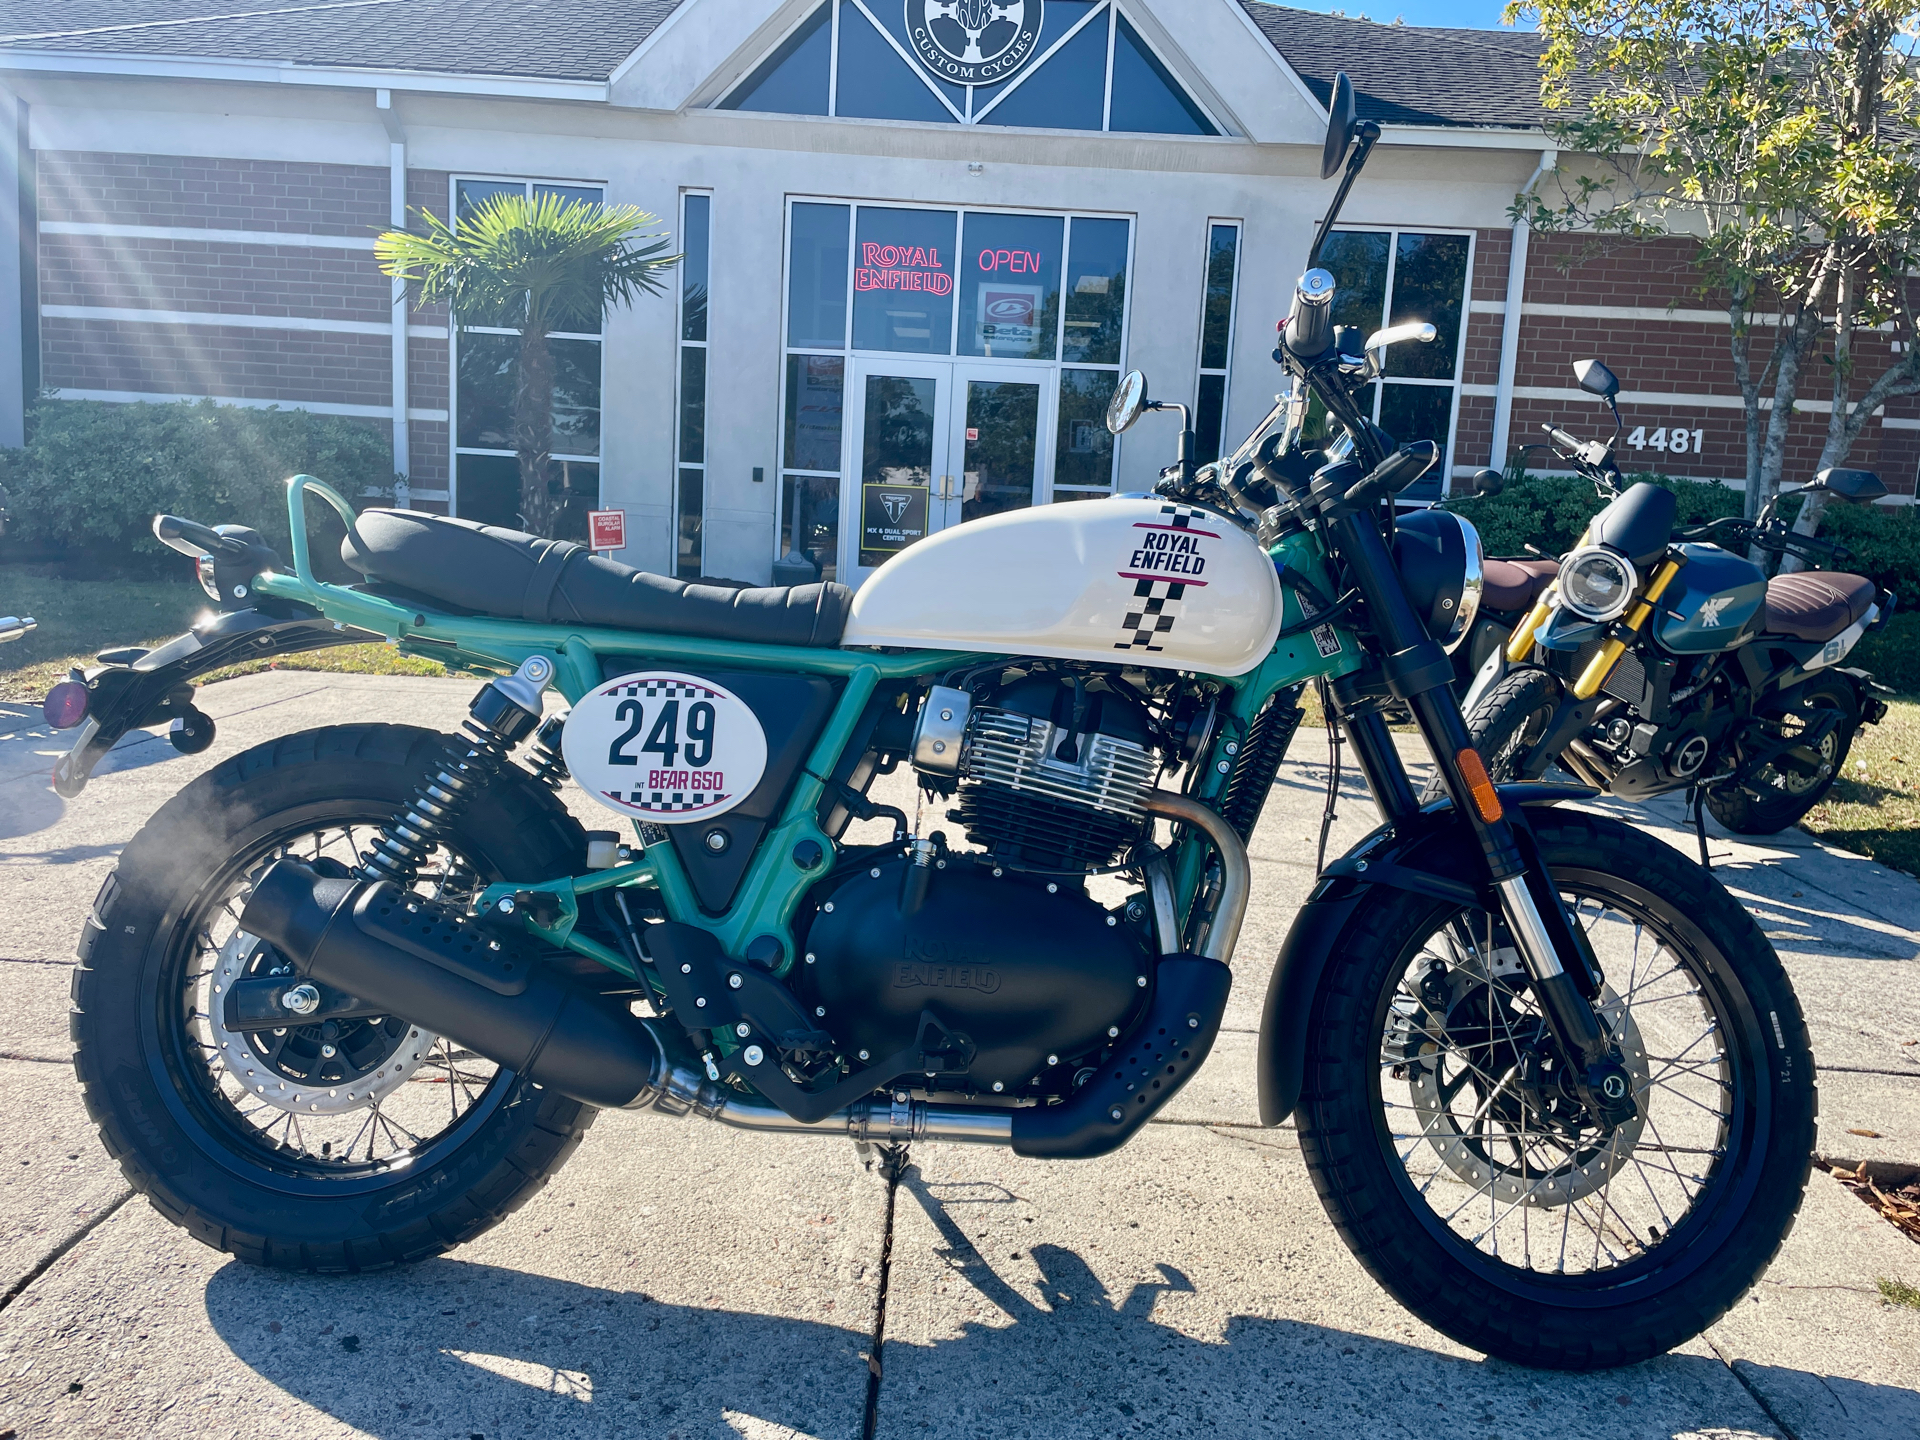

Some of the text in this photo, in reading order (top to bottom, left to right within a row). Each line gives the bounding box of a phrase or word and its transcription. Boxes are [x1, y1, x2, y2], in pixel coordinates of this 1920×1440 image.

[914, 27, 1033, 78] CUSTOM CYCLES
[862, 242, 942, 268] ROYAL
[979, 249, 1040, 273] OPEN
[855, 268, 953, 296] ENFIELD
[983, 325, 1032, 336] Beta
[1627, 426, 1703, 453] 4481
[1143, 532, 1200, 555] ROYAL
[1129, 550, 1206, 575] ENFIELD
[608, 699, 716, 768] 249
[634, 770, 724, 791] INT BEAR 650
[1635, 866, 1701, 905] MRF
[904, 934, 991, 965] ROYAL
[893, 963, 1002, 995] ENFIELD
[1780, 1070, 1792, 1083] 21
[116, 1080, 168, 1149] MRF
